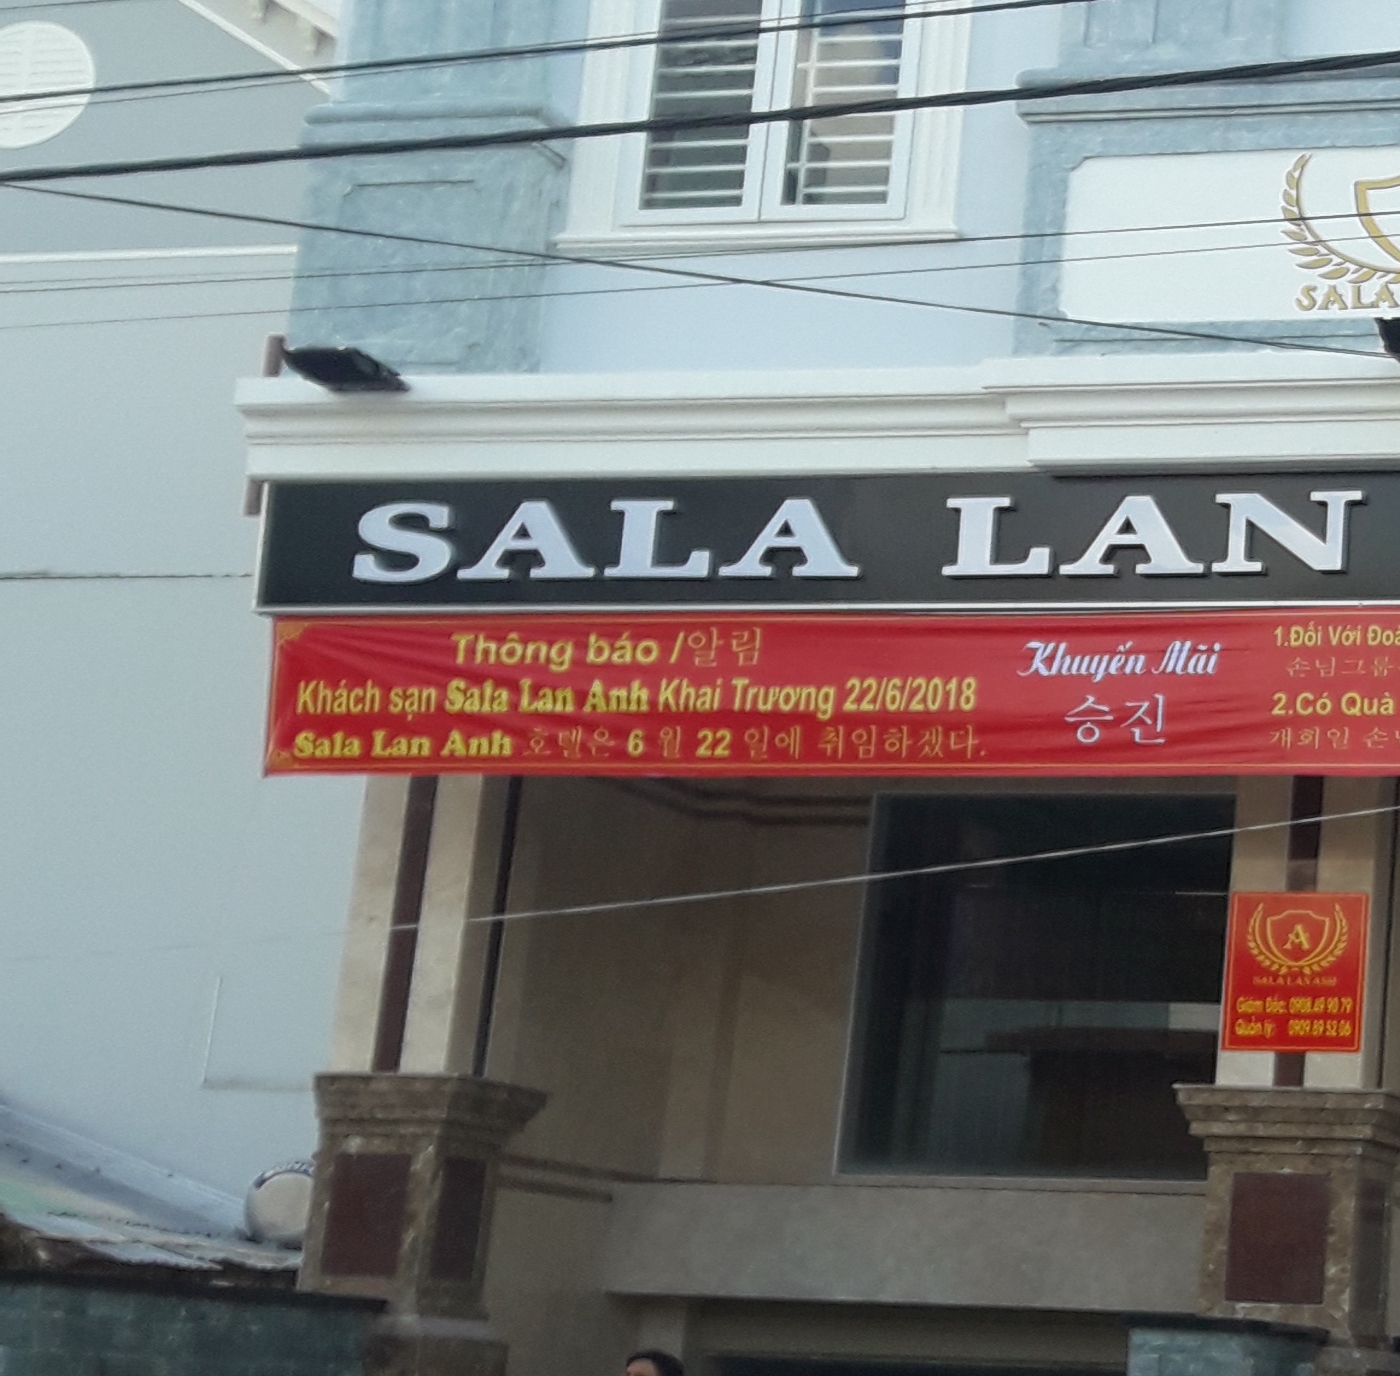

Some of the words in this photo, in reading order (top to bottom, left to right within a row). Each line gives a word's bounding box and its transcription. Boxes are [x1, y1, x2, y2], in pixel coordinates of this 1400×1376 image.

[1296, 281, 1400, 312] SALA
[351, 498, 861, 583] SALA
[942, 489, 1363, 575] LAN
[452, 632, 574, 672] Thông
[586, 631, 659, 665] báo
[1328, 624, 1361, 646] Với
[1017, 640, 1147, 683] Khuyến
[1152, 640, 1222, 675] Mãi
[297, 679, 381, 714] Khách
[389, 686, 437, 721] sạn
[445, 678, 509, 714] Sala
[519, 678, 574, 713] Lan
[583, 678, 649, 713] Anh
[658, 677, 722, 712] Khai
[731, 677, 835, 721] Trương
[843, 676, 976, 712] 22/6/2018
[1064, 693, 1166, 744] 승진
[1271, 691, 1332, 715] 2.Có
[1341, 691, 1394, 716] Quà
[294, 730, 361, 758] Sala
[371, 729, 431, 757] Lan
[440, 729, 512, 757] Anh
[627, 729, 645, 757] 6
[696, 728, 732, 758] 22
